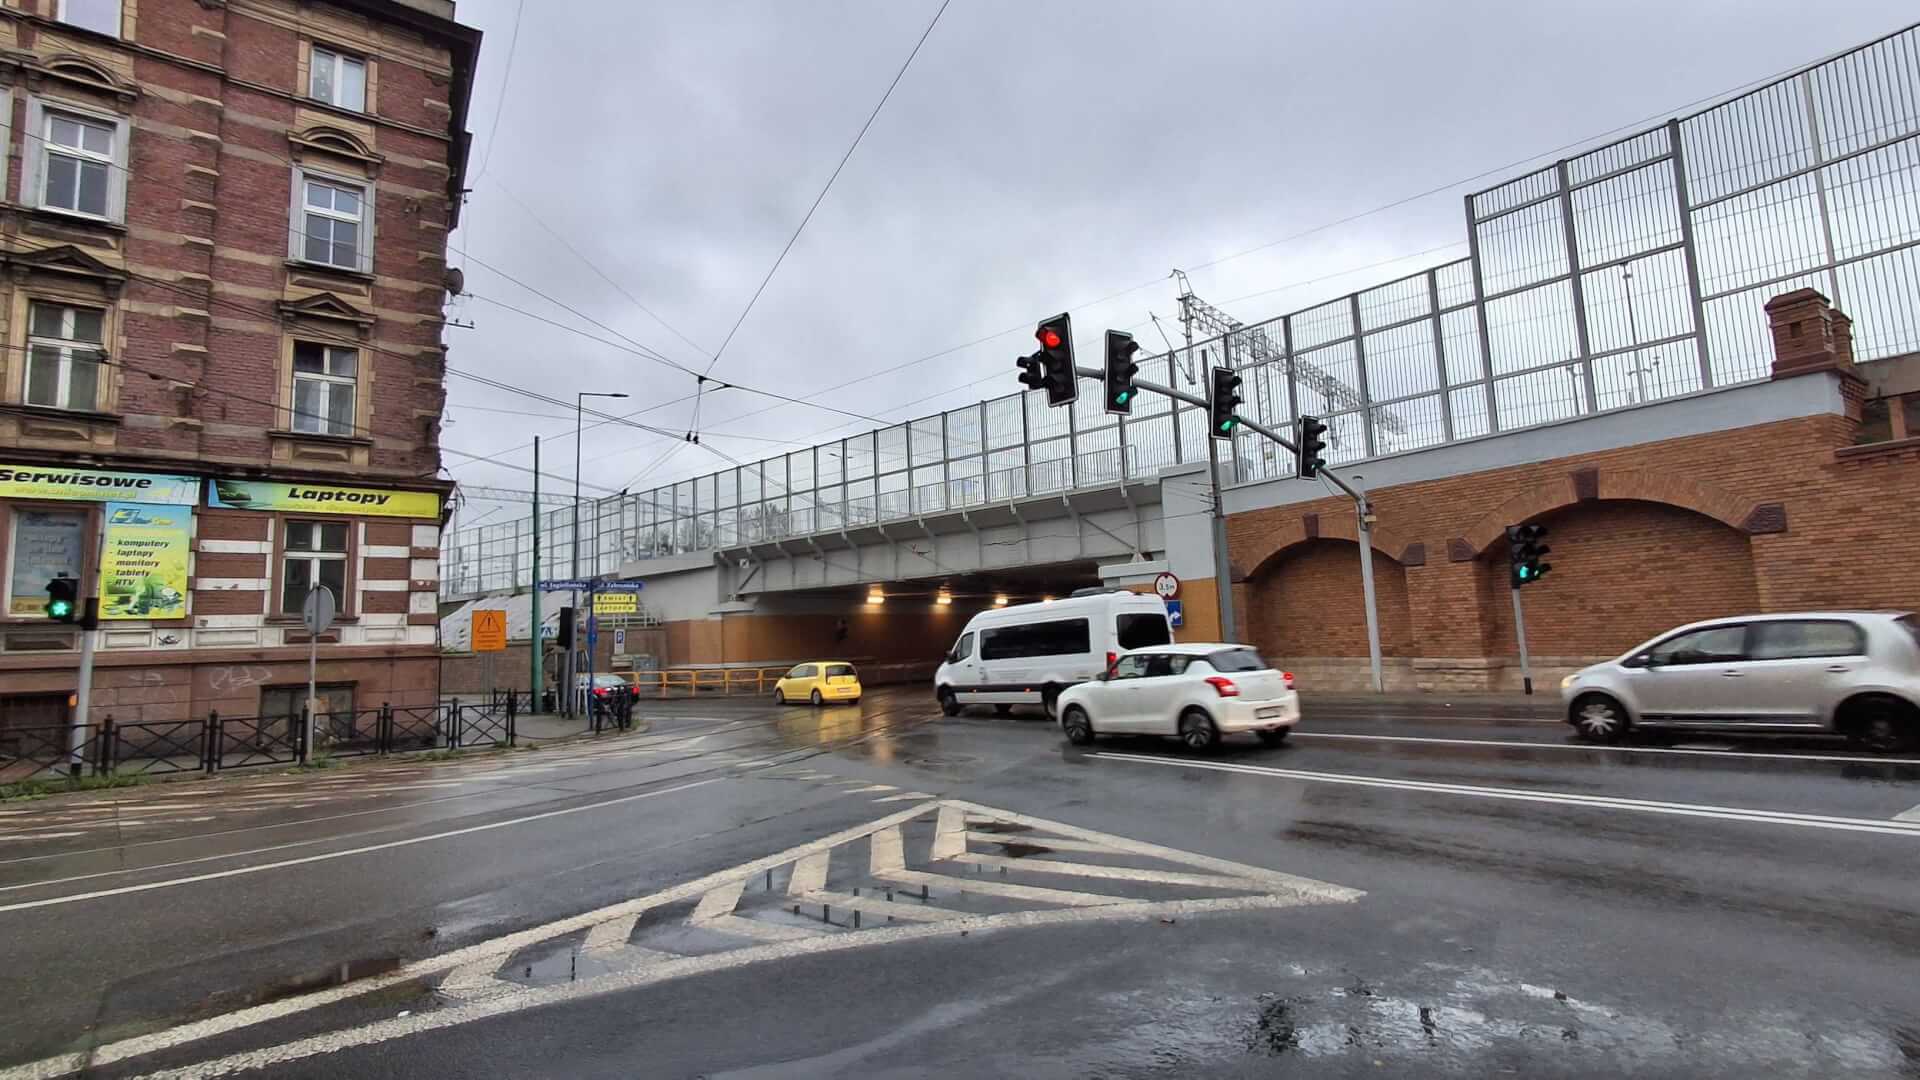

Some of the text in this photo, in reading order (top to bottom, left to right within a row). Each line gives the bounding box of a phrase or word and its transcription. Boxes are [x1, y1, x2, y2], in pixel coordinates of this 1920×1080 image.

[0, 469, 152, 489] Serwisowe
[288, 487, 391, 505] Laptopy
[117, 539, 170, 548] komputery
[115, 568, 151, 577] tablety
